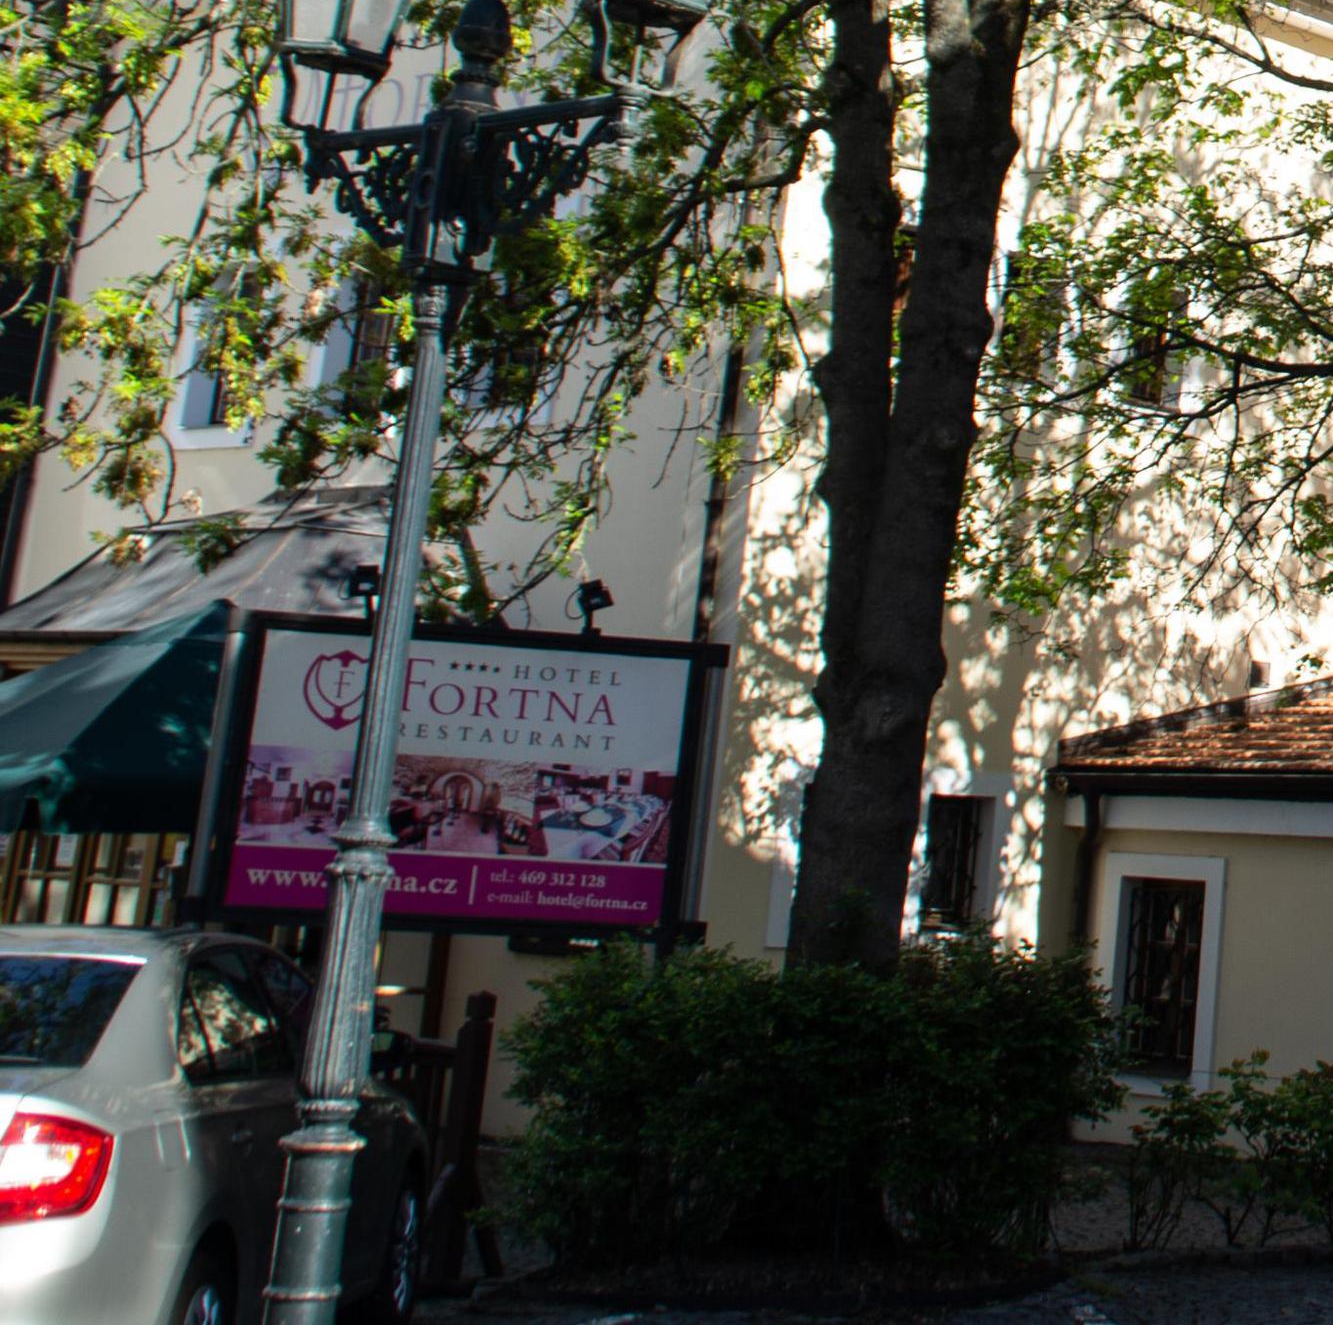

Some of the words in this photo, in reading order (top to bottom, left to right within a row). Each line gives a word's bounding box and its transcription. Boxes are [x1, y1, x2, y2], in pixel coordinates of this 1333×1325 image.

[514, 664, 621, 686] HOTEL
[401, 657, 617, 725] FORTNA
[246, 868, 458, 894] www.na.cz
[518, 870, 546, 884] 469
[549, 872, 575, 886] 312
[580, 874, 606, 888] 128
[487, 892, 533, 904] e-mail:
[537, 891, 647, 910] hotel@fortna.cz
